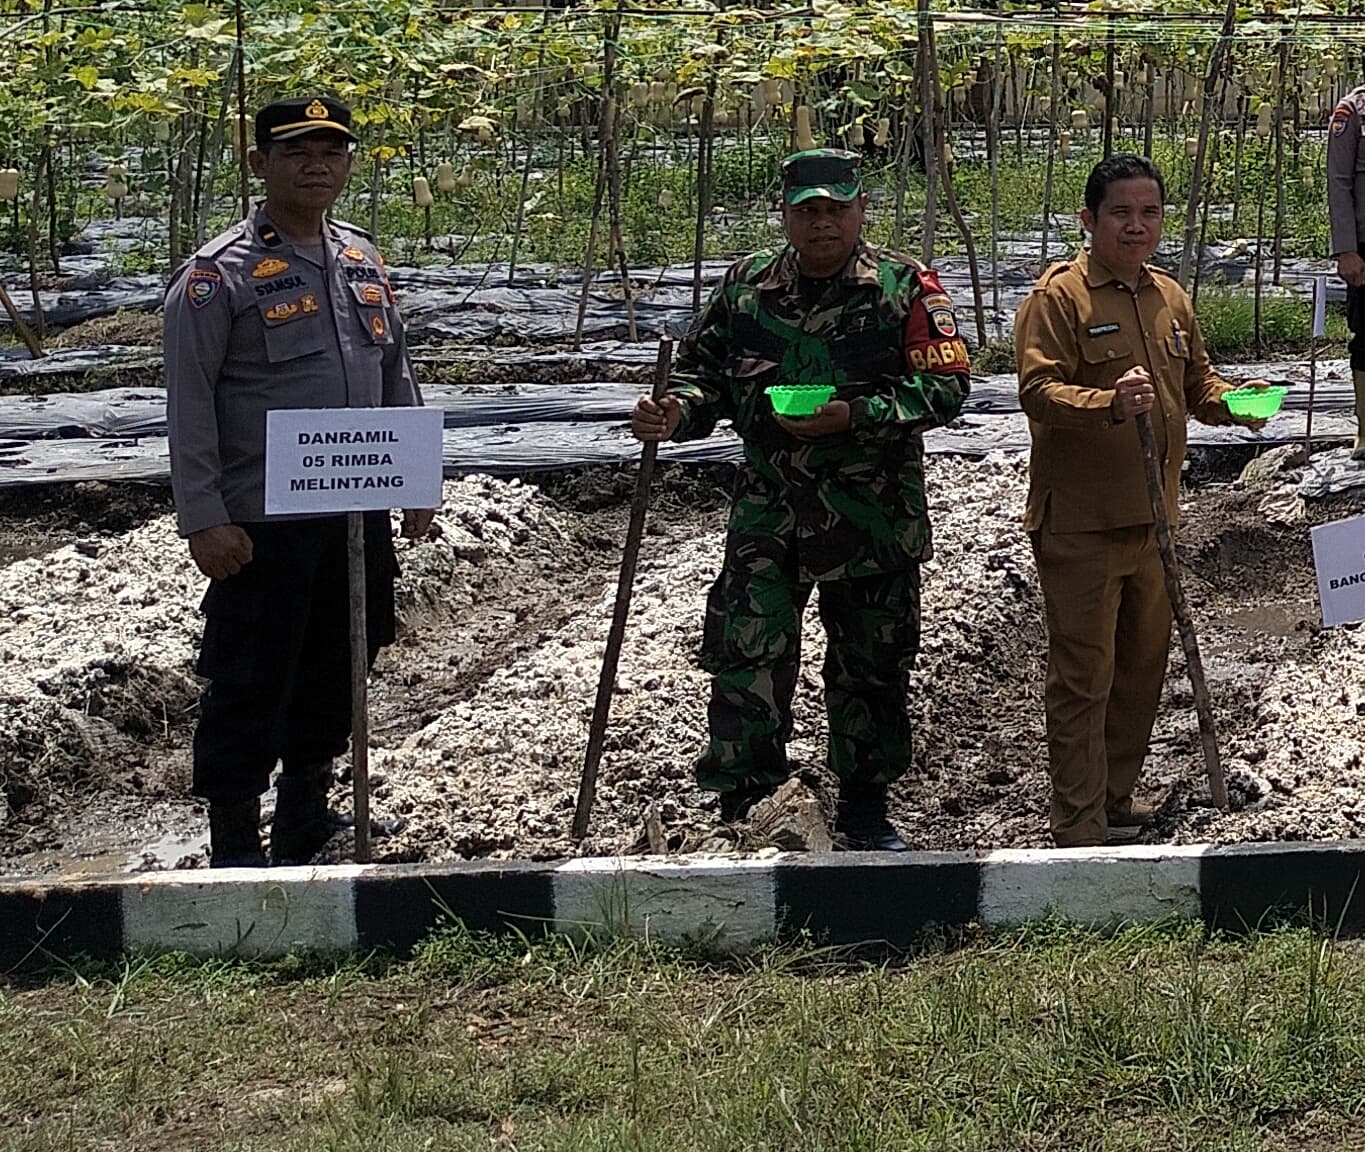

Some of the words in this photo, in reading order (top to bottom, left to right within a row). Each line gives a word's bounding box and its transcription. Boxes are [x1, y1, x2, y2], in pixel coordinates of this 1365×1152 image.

[298, 430, 399, 445] DANRAMIL
[302, 455, 325, 468] 05
[331, 453, 393, 467] RIMBA
[290, 475, 404, 491] MELINTANG
